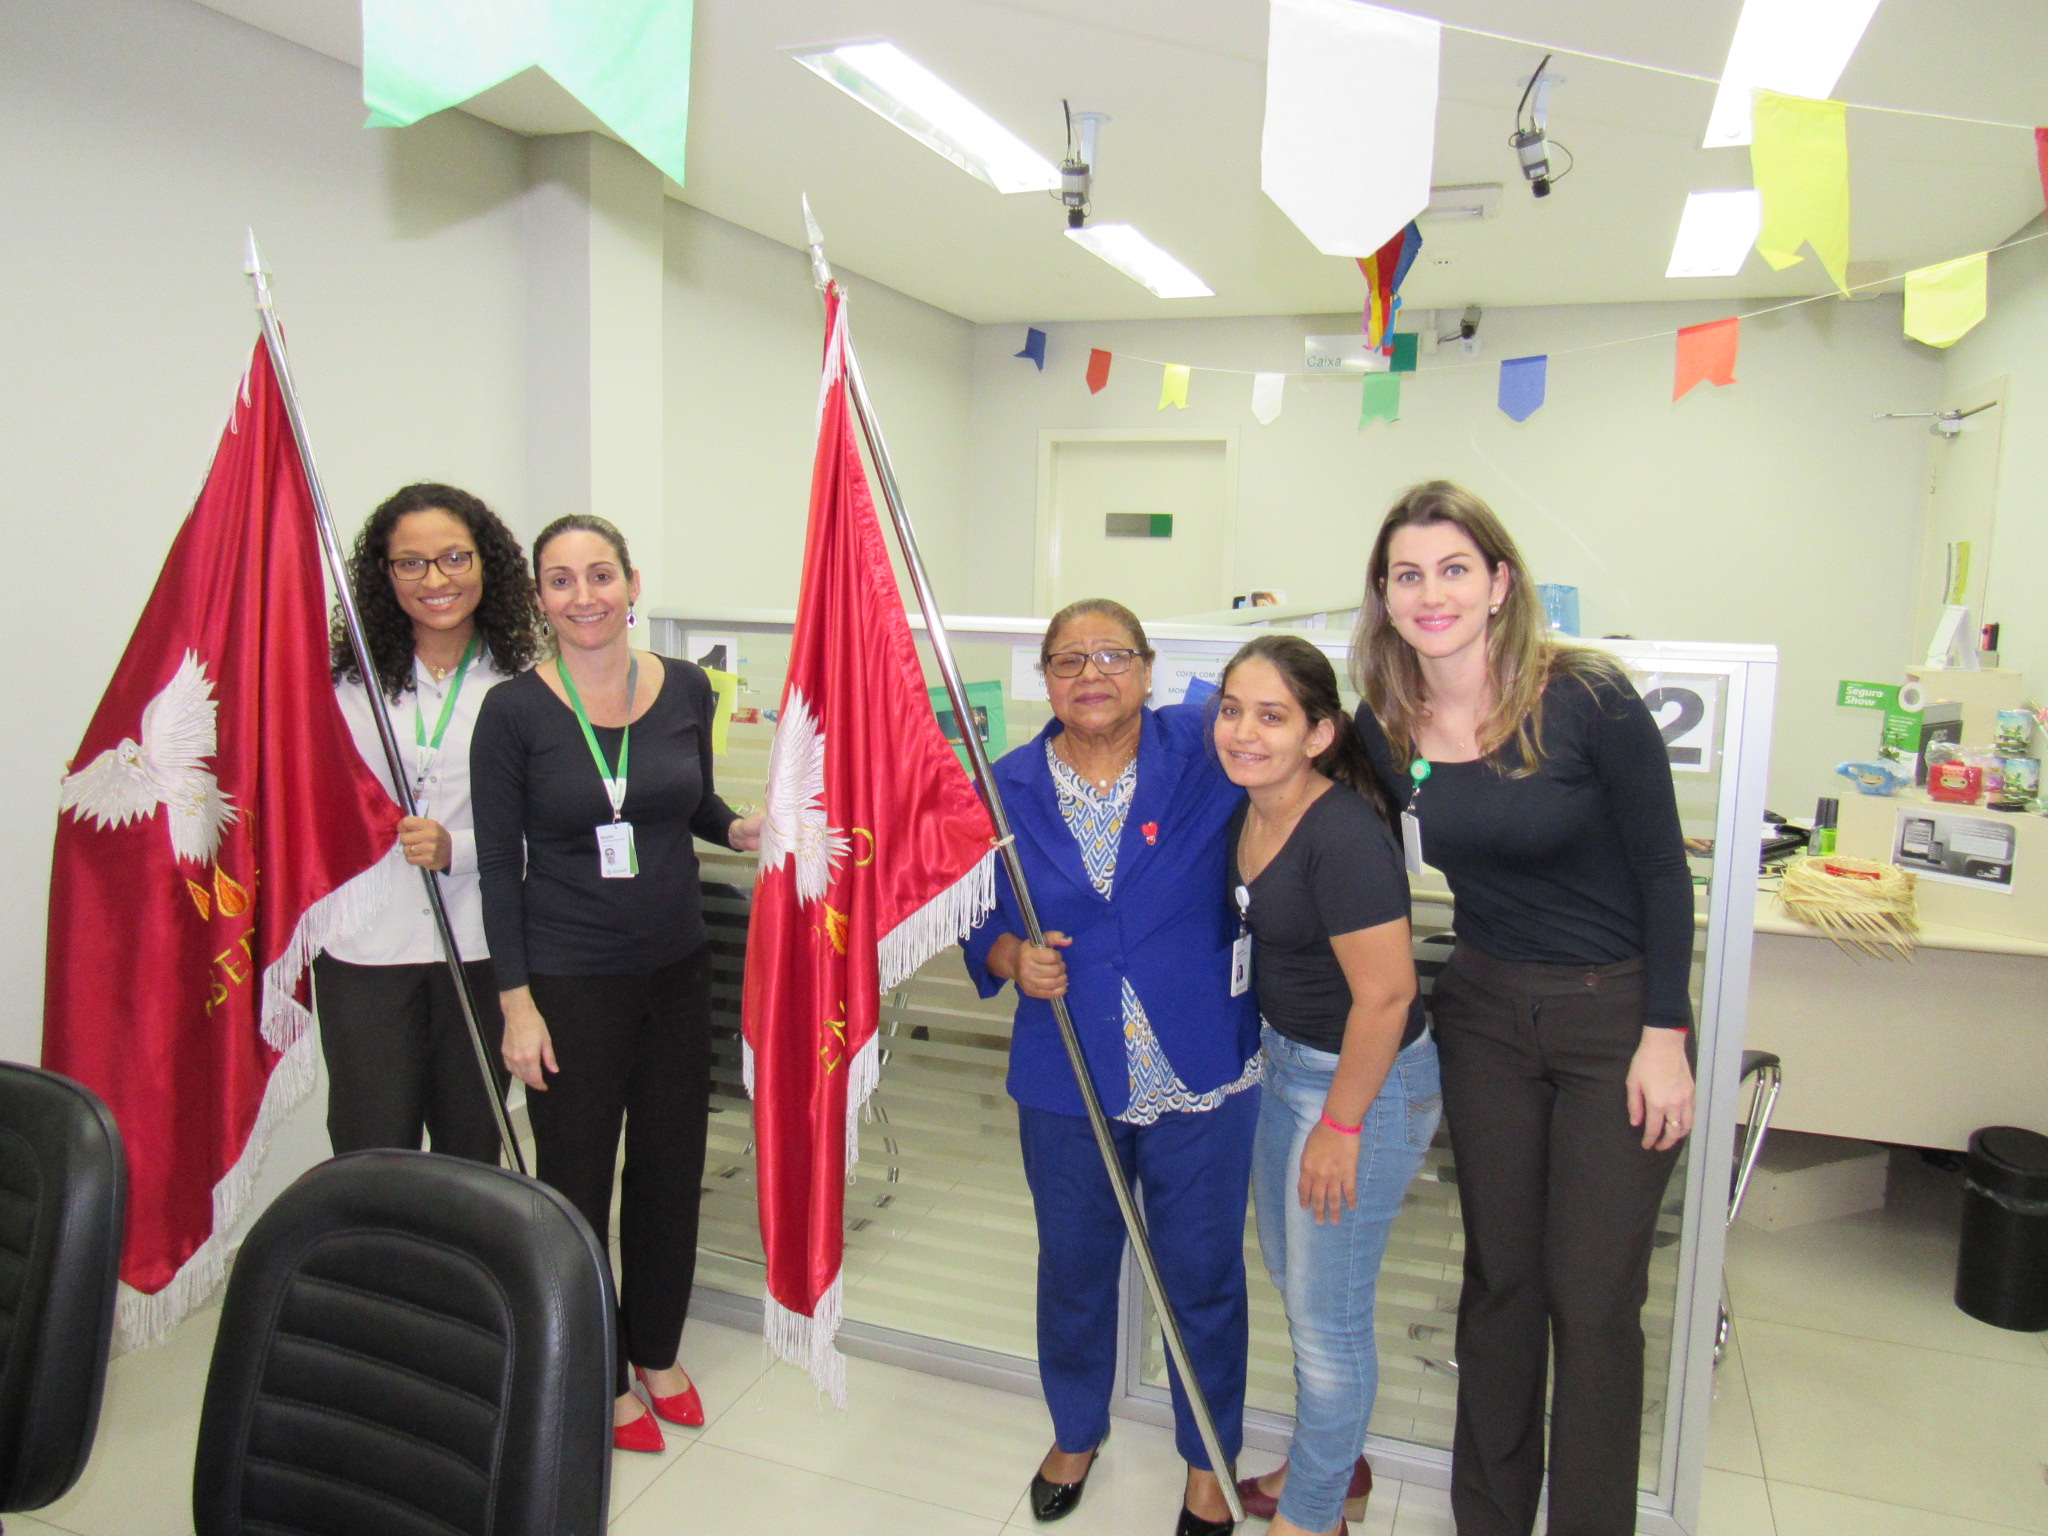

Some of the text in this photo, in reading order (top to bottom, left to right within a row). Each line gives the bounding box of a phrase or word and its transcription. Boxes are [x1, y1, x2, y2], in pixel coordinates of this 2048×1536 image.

[1306, 355, 1342, 368] Caixa
[1843, 695, 1877, 706] Show
[1642, 686, 1705, 765] 2
